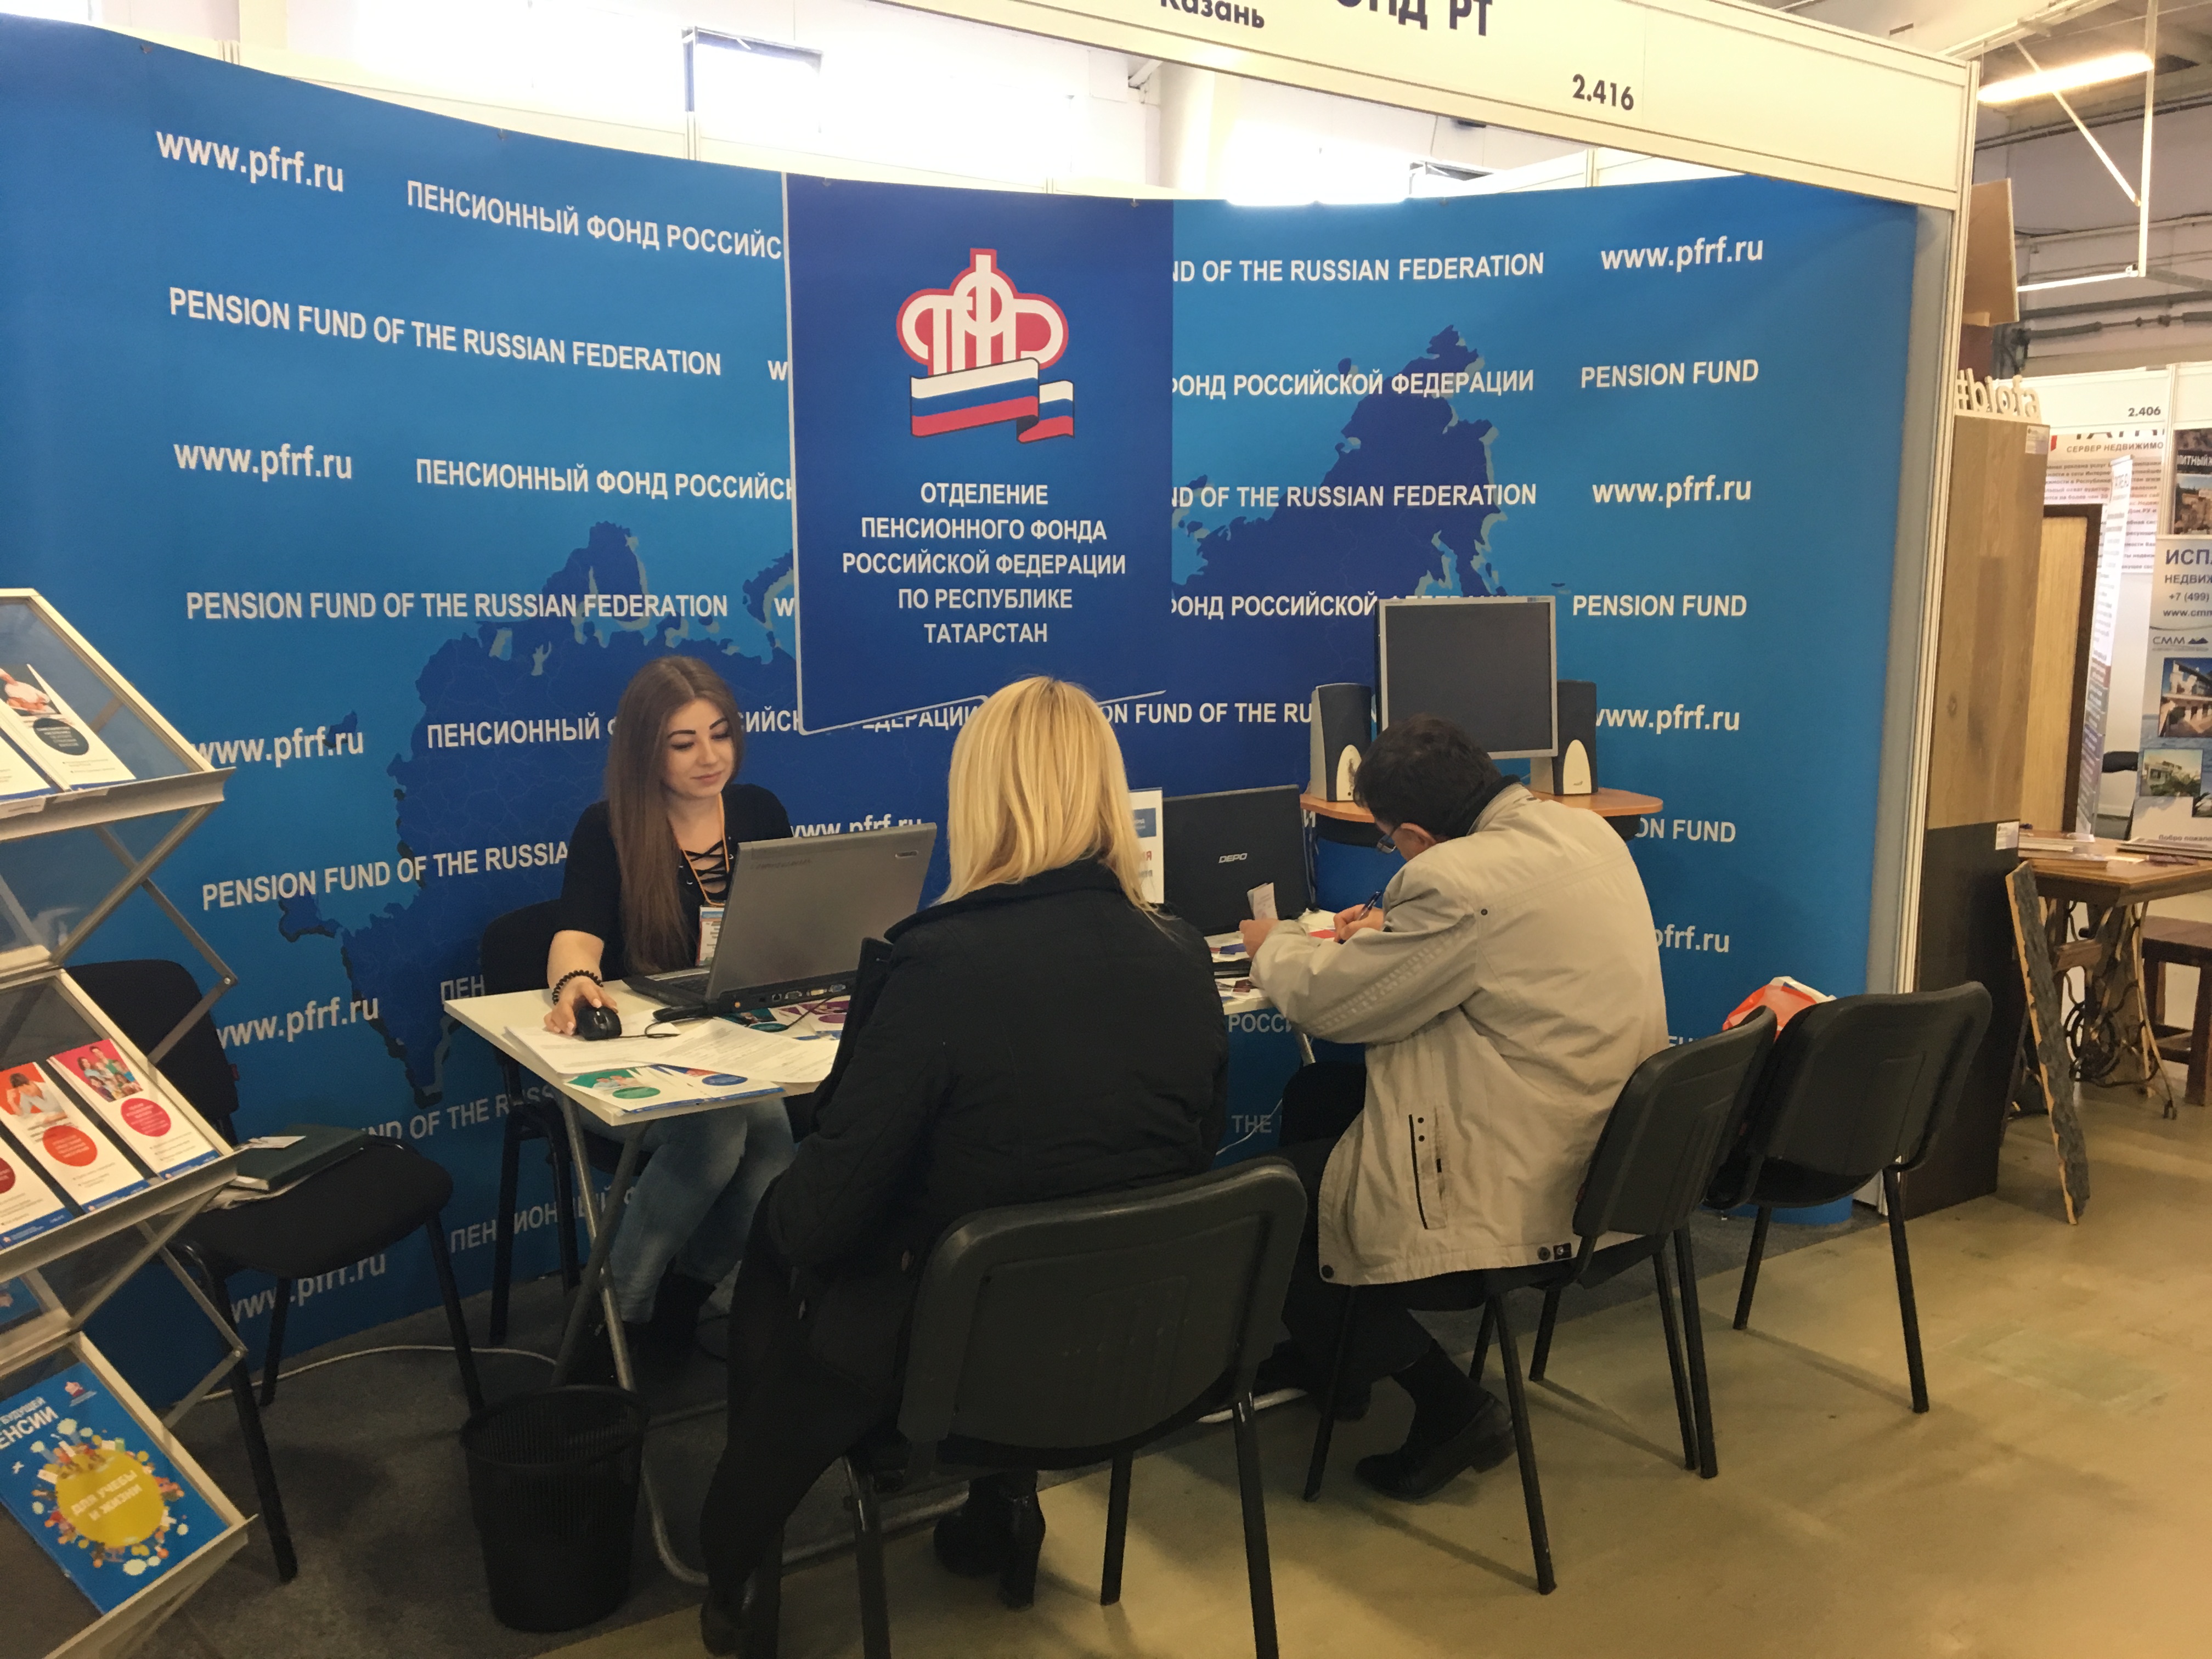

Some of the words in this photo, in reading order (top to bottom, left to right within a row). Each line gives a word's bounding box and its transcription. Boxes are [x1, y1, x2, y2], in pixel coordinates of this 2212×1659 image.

[1572, 74, 1634, 110] 2.416
[156, 132, 343, 191] www.pfrf.ru
[408, 180, 579, 236] ПЕНСИОННЫЙ
[587, 216, 659, 250] ФОНД
[667, 225, 781, 259] РОССИЙС
[1203, 261, 1232, 281] OF
[1239, 260, 1282, 281] THE
[1291, 259, 1389, 281] RUSSIAN
[1400, 252, 1543, 280] FEDERATION
[1601, 236, 1763, 272] www.pfrf.ru
[170, 287, 289, 330] PENSION
[299, 306, 366, 338] FUND
[374, 317, 404, 343] OF
[411, 321, 456, 351] THE
[464, 329, 565, 363] RUSSIAN
[573, 342, 720, 375] FEDERATION
[1234, 369, 1383, 396] РОССИЙСКОЙ
[1392, 370, 1533, 397] ФЕДЕРАЦИИ
[1582, 363, 1684, 388] PENSION
[1694, 359, 1758, 383] FUND
[2128, 406, 2162, 417] 2.406
[174, 443, 351, 482] www.pfrf.ru
[417, 459, 588, 492] ПЕНСИОННЫЙ
[597, 470, 668, 499] ФОНД
[1593, 475, 1751, 508] www.pfrf.ru
[921, 483, 1048, 507] ОТДЕЛЕНИЕ
[1201, 487, 1229, 507] OF
[1237, 487, 1279, 507] THE
[1288, 486, 1383, 506] RUSSIAN
[1394, 484, 1536, 506] FEDERATION
[862, 517, 1024, 539] ПЕНСИОННОГО
[1031, 520, 1107, 543] ФОНДА
[843, 549, 989, 573] РОССИЙСКОЙ
[996, 555, 1125, 578] ФЕДЕРАЦИИ
[2165, 549, 2212, 565] ИСП
[187, 592, 302, 619] PENSION
[311, 592, 376, 618] FUND
[383, 593, 414, 617] OF
[421, 593, 467, 617] THE
[475, 594, 577, 617] RUSSIAN
[584, 594, 727, 617] FEDERATION
[899, 589, 928, 608] ПО
[935, 589, 1072, 608] РЕСПУБЛИКЕ
[1232, 591, 1378, 616] РОССИЙСКОЙ
[1573, 595, 1674, 616] PENSION
[1683, 595, 1746, 616] FUND
[2169, 592, 2181, 601] +7
[2184, 592, 2210, 602] (499)
[924, 623, 1047, 643] ТАТАРСТАН
[1136, 703, 1192, 723] FUND
[1200, 703, 1227, 723] OF
[1235, 703, 1276, 722] THE
[428, 712, 599, 748] ПЕНСИОННЫЙ
[1673, 820, 1736, 842] FUND
[1218, 853, 1248, 864] DEPO
[203, 871, 315, 910] PENSION
[325, 862, 390, 893] FUND
[397, 856, 426, 882] OF
[433, 850, 478, 877] THE
[410, 1111, 440, 1139] OF
[447, 1098, 489, 1129] THE
[1231, 1114, 1272, 1133] THE
